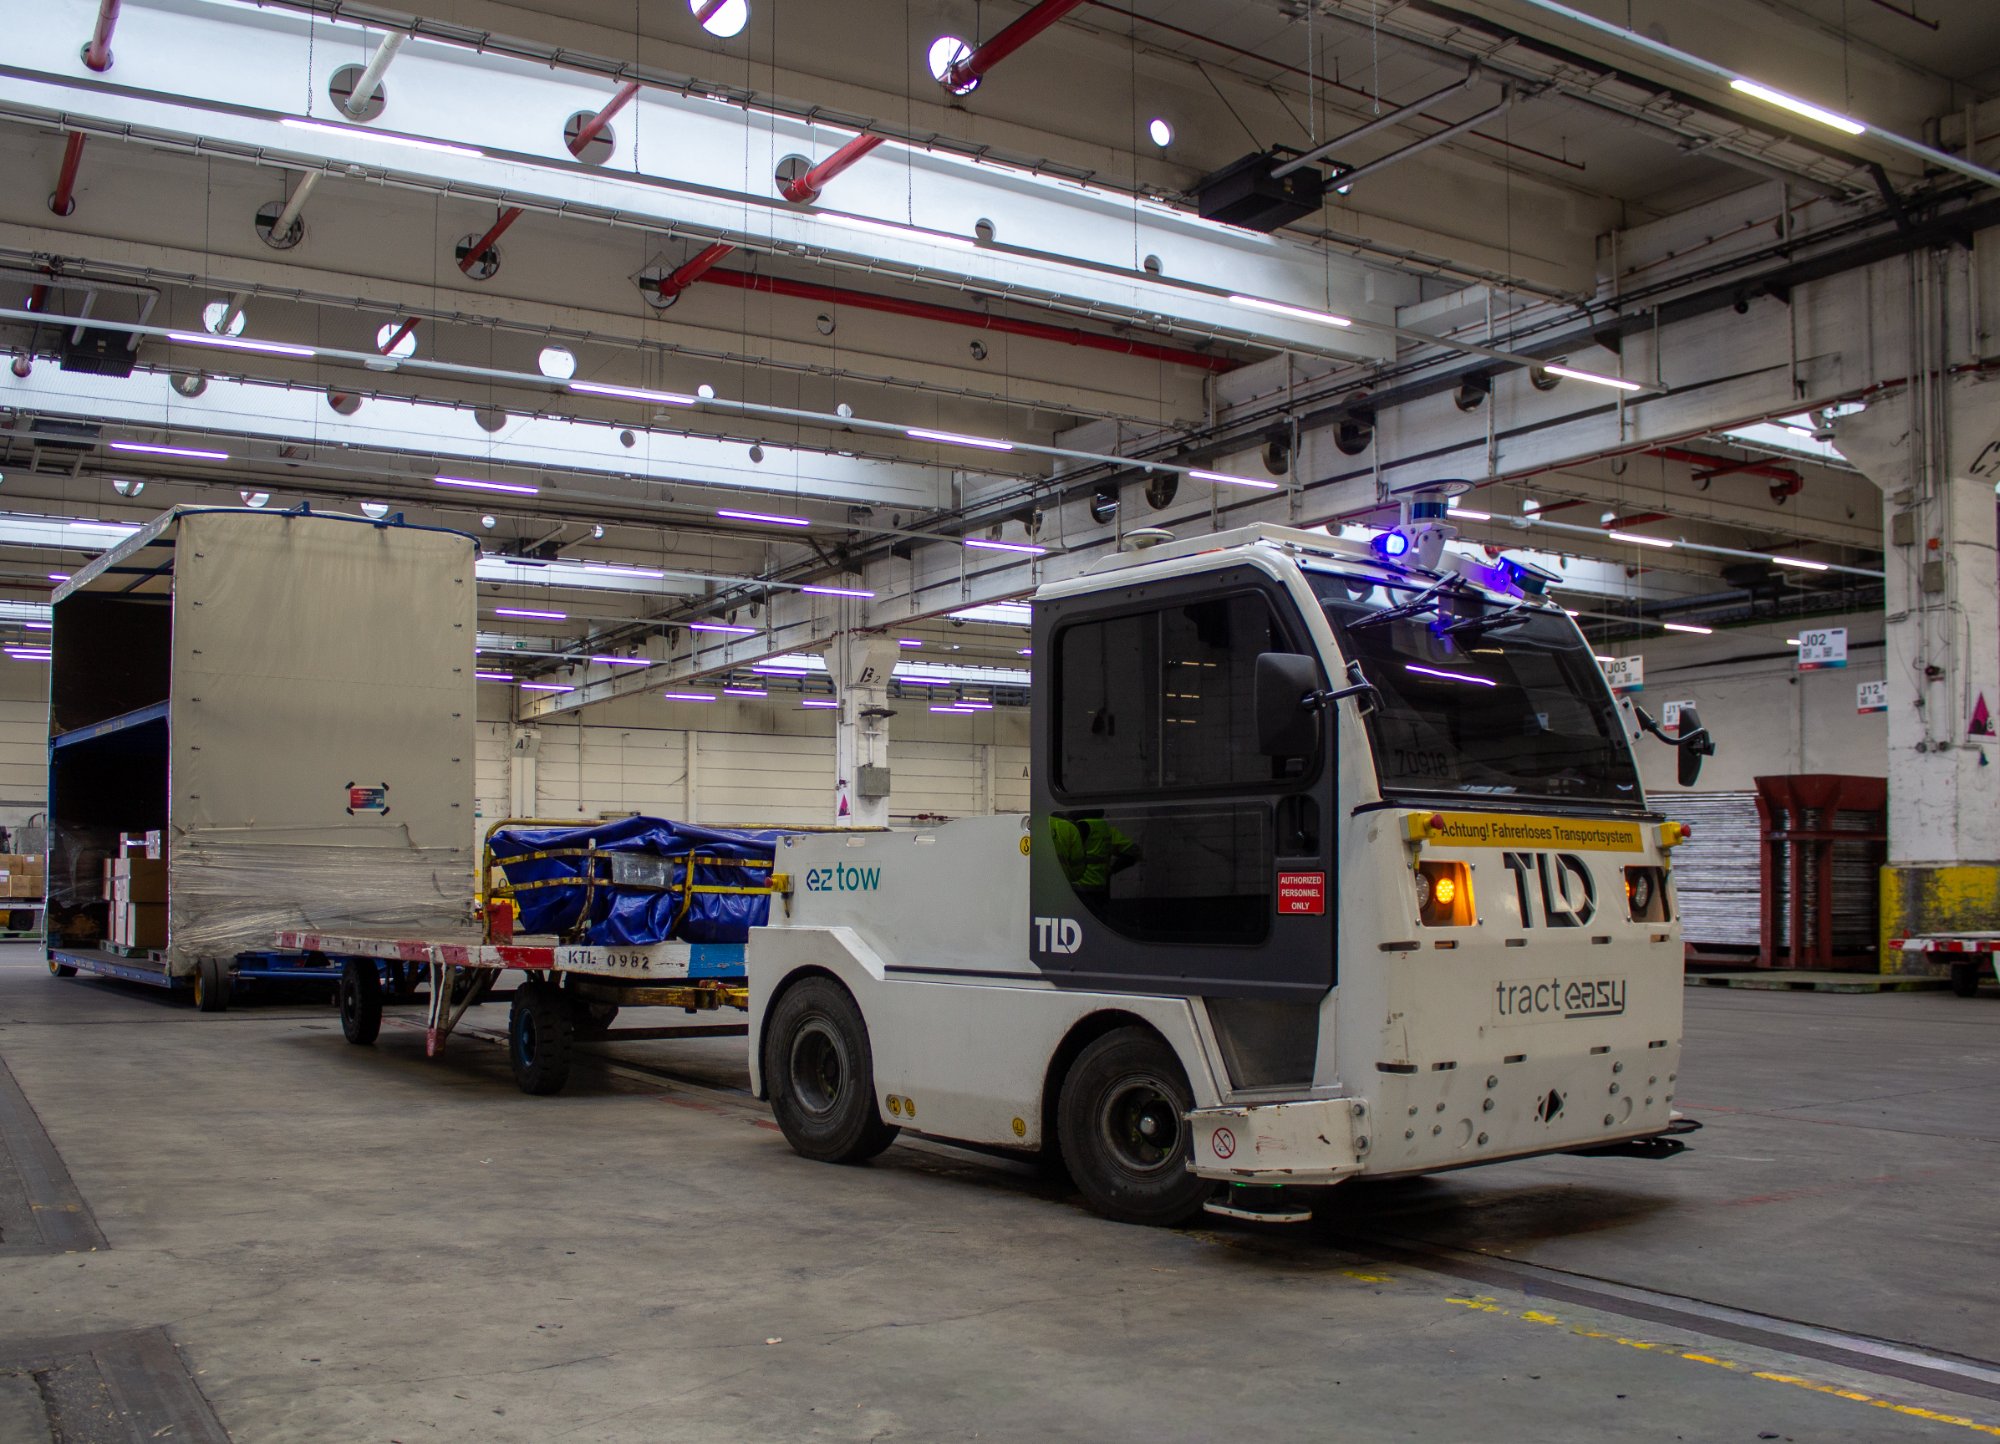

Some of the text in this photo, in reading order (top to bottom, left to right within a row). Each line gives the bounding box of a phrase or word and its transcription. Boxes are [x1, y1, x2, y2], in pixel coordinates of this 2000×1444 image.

[1803, 633, 1827, 647] J02
[1608, 661, 1627, 674] J03
[1860, 684, 1880, 696] J12
[1441, 821, 1634, 847] Achtung! Fahrerloses Transportsystem
[1280, 876, 1322, 885] AUTHORIZED
[1281, 888, 1321, 897] PERSONNEL
[1502, 851, 1598, 929] TLD
[1291, 901, 1310, 910] ONLY
[1034, 916, 1083, 954] TLD
[606, 953, 650, 971] 0982
